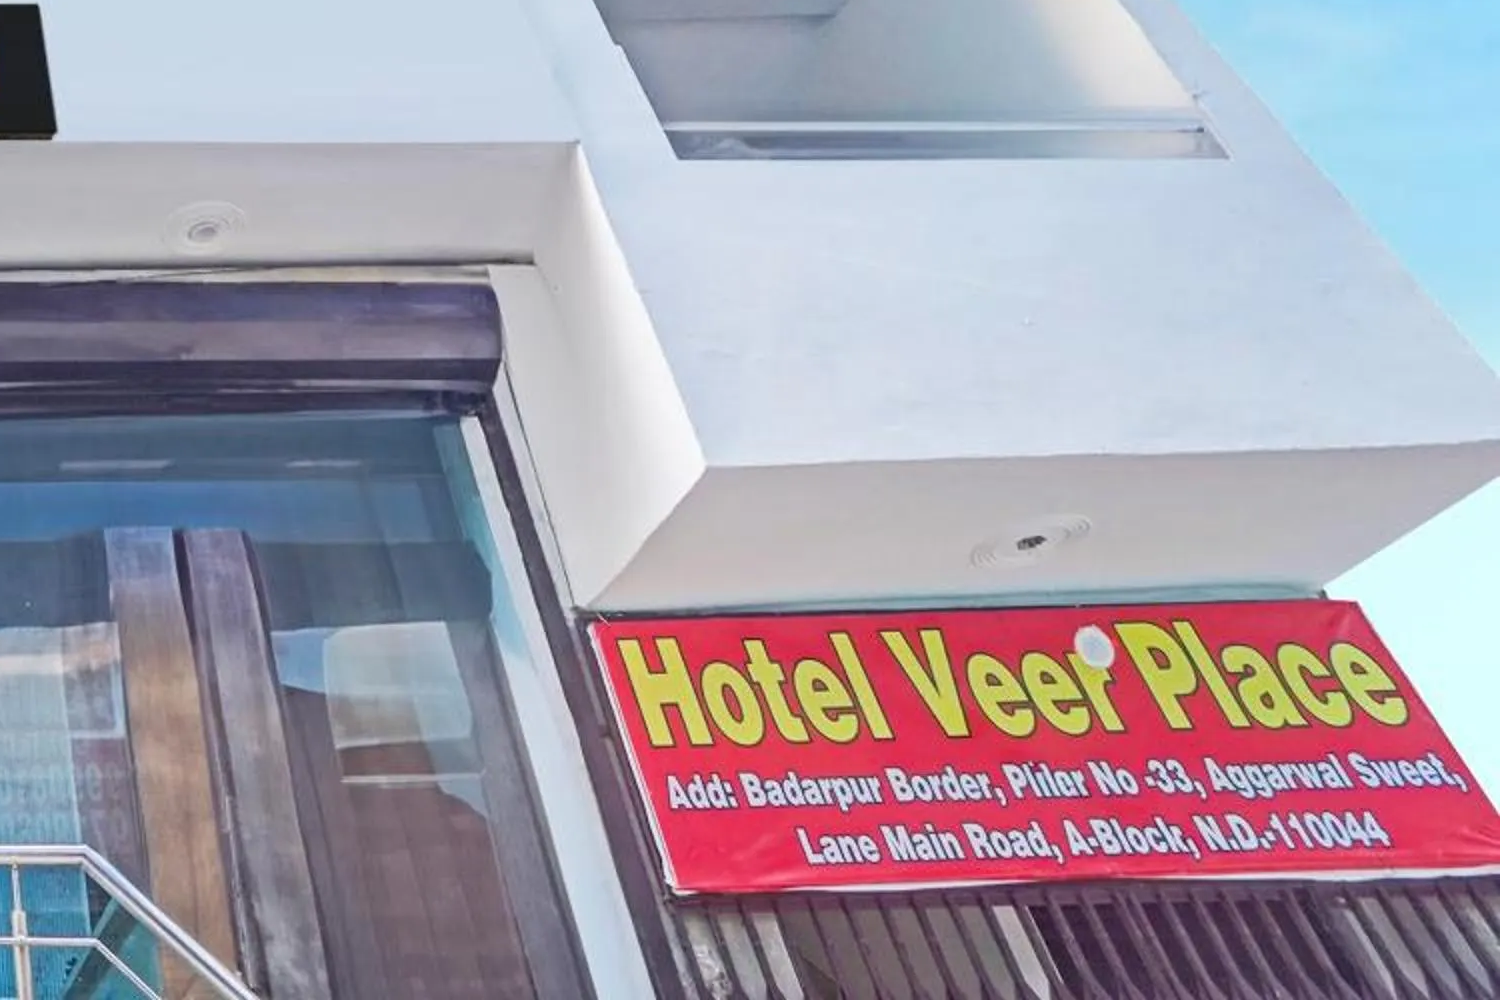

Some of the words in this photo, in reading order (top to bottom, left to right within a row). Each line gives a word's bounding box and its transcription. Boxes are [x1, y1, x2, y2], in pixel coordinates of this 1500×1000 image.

[616, 631, 896, 748] Hotel
[878, 628, 1127, 739] Veer
[1112, 620, 1409, 730] Place
[667, 774, 738, 809] Add:
[738, 771, 883, 812] Badarpur
[884, 766, 1007, 807] Border,
[1087, 760, 1140, 796] No
[1204, 752, 1354, 799] Aggarwal
[1348, 751, 1469, 793] Sweet,
[796, 827, 881, 864] Lane
[880, 824, 965, 861] Main
[962, 820, 1065, 865] Road,
